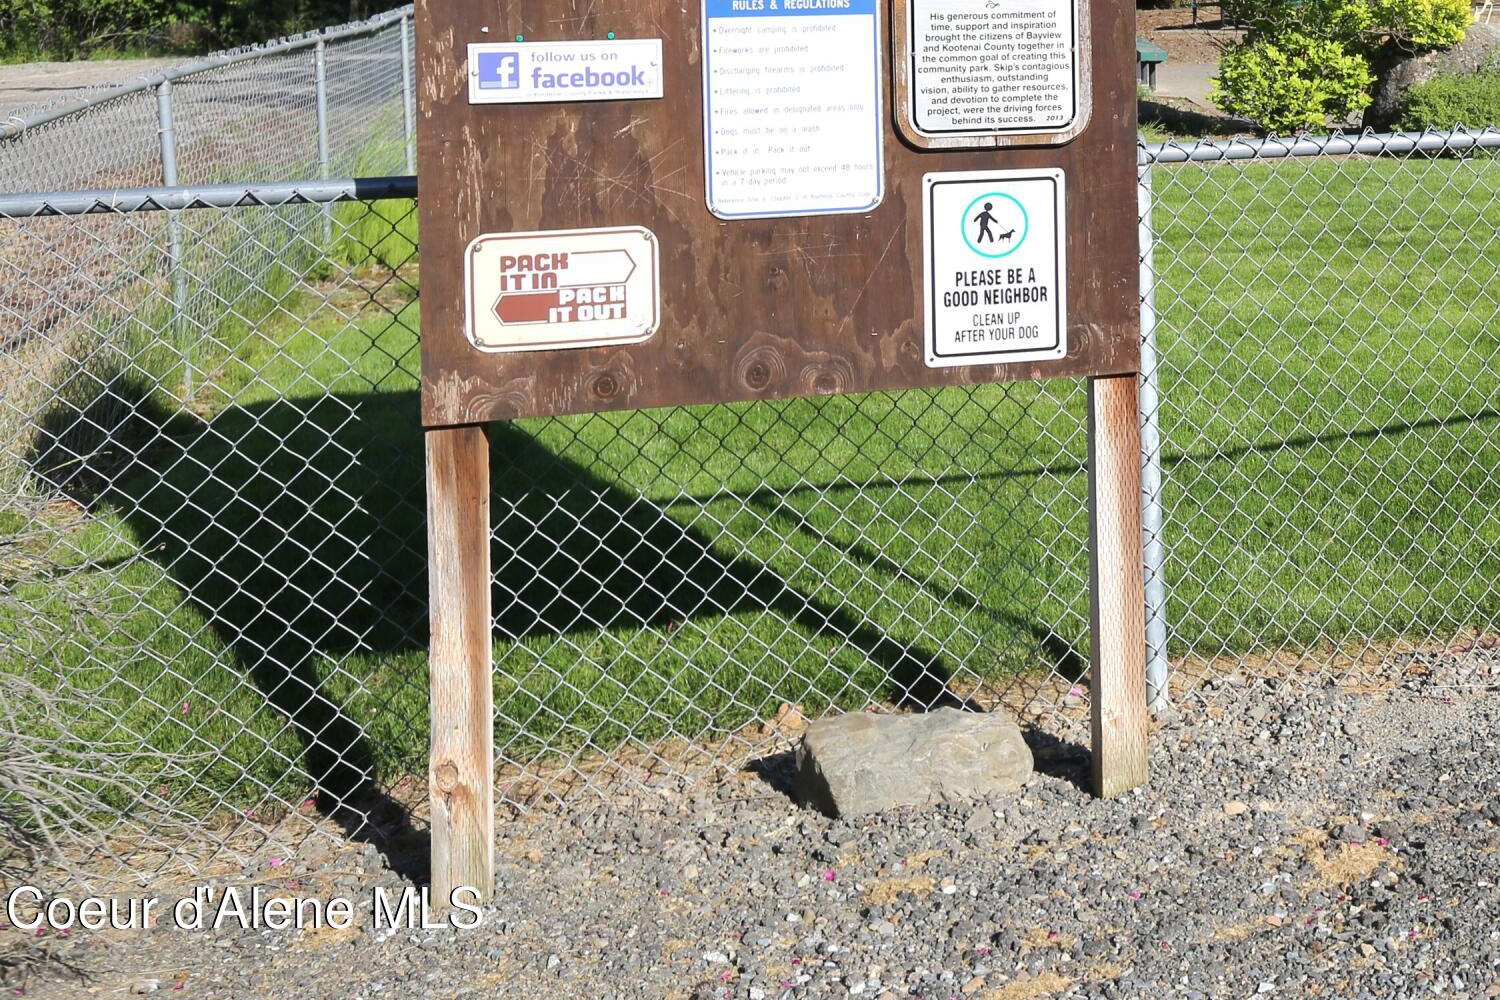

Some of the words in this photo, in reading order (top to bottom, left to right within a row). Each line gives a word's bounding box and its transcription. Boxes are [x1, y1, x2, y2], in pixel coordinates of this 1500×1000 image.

[732, 0, 764, 11] RULES
[770, 0, 778, 10] &
[930, 12, 944, 20] His
[947, 13, 989, 22] generous
[991, 11, 1045, 20] commitment
[1048, 10, 1056, 18] of
[931, 23, 953, 32] time,
[955, 22, 990, 32] support
[992, 22, 1008, 30] and
[1010, 21, 1057, 31] inspiration
[925, 34, 961, 43] brought
[962, 33, 977, 41] the
[979, 32, 1012, 40] citizens
[1015, 32, 1024, 40] of
[1026, 31, 1062, 42] Bayview
[923, 44, 940, 52] and
[942, 43, 982, 52] Kootenai
[984, 42, 1016, 53] County
[1018, 42, 1054, 52] together
[1056, 42, 1065, 50] in
[531, 51, 575, 63] follow
[580, 52, 597, 62] us
[600, 52, 618, 62] on
[922, 55, 936, 63] the
[980, 54, 999, 63] goal
[1001, 54, 1010, 62] of
[1012, 53, 1048, 62] creating
[1050, 52, 1066, 60] this
[497, 56, 515, 88] f
[918, 65, 967, 75] community
[970, 64, 991, 74] park.
[994, 63, 1020, 73] Skip's
[1022, 62, 1070, 72] contagious
[531, 65, 646, 89] facebook
[940, 75, 995, 84] enthusiasm,
[996, 74, 1049, 82] outstanding
[920, 86, 950, 95] vision,
[952, 85, 978, 95] ability
[980, 85, 990, 93] to
[992, 85, 1020, 94] gather
[1022, 84, 1068, 92] resources,
[931, 96, 948, 104] and
[950, 96, 988, 104] devotion
[990, 95, 1000, 103] to
[1002, 94, 1042, 103] complete
[1044, 93, 1058, 101] the
[928, 107, 961, 116] project,
[1003, 104, 1032, 114] driving
[1035, 103, 1062, 111] forces
[952, 117, 982, 125] behind
[984, 116, 995, 124] its
[997, 116, 1036, 124] success.
[1046, 114, 1064, 122] 2013
[500, 252, 568, 272] PACK
[500, 274, 526, 291] IT
[532, 272, 558, 289] IN
[955, 269, 1002, 287] PLEASE
[1008, 268, 1022, 284] BE
[1028, 267, 1036, 283] A
[558, 286, 625, 305] PACK
[944, 290, 978, 308] GOOD
[984, 286, 1048, 305] NEIGHBOR
[548, 306, 573, 323] IT
[577, 304, 625, 321] OUT
[972, 312, 1004, 327] CLEAN
[1008, 312, 1020, 325] UP
[954, 329, 985, 342] AFTER
[988, 327, 1015, 341] YOUR
[1018, 325, 1039, 339] DOG
